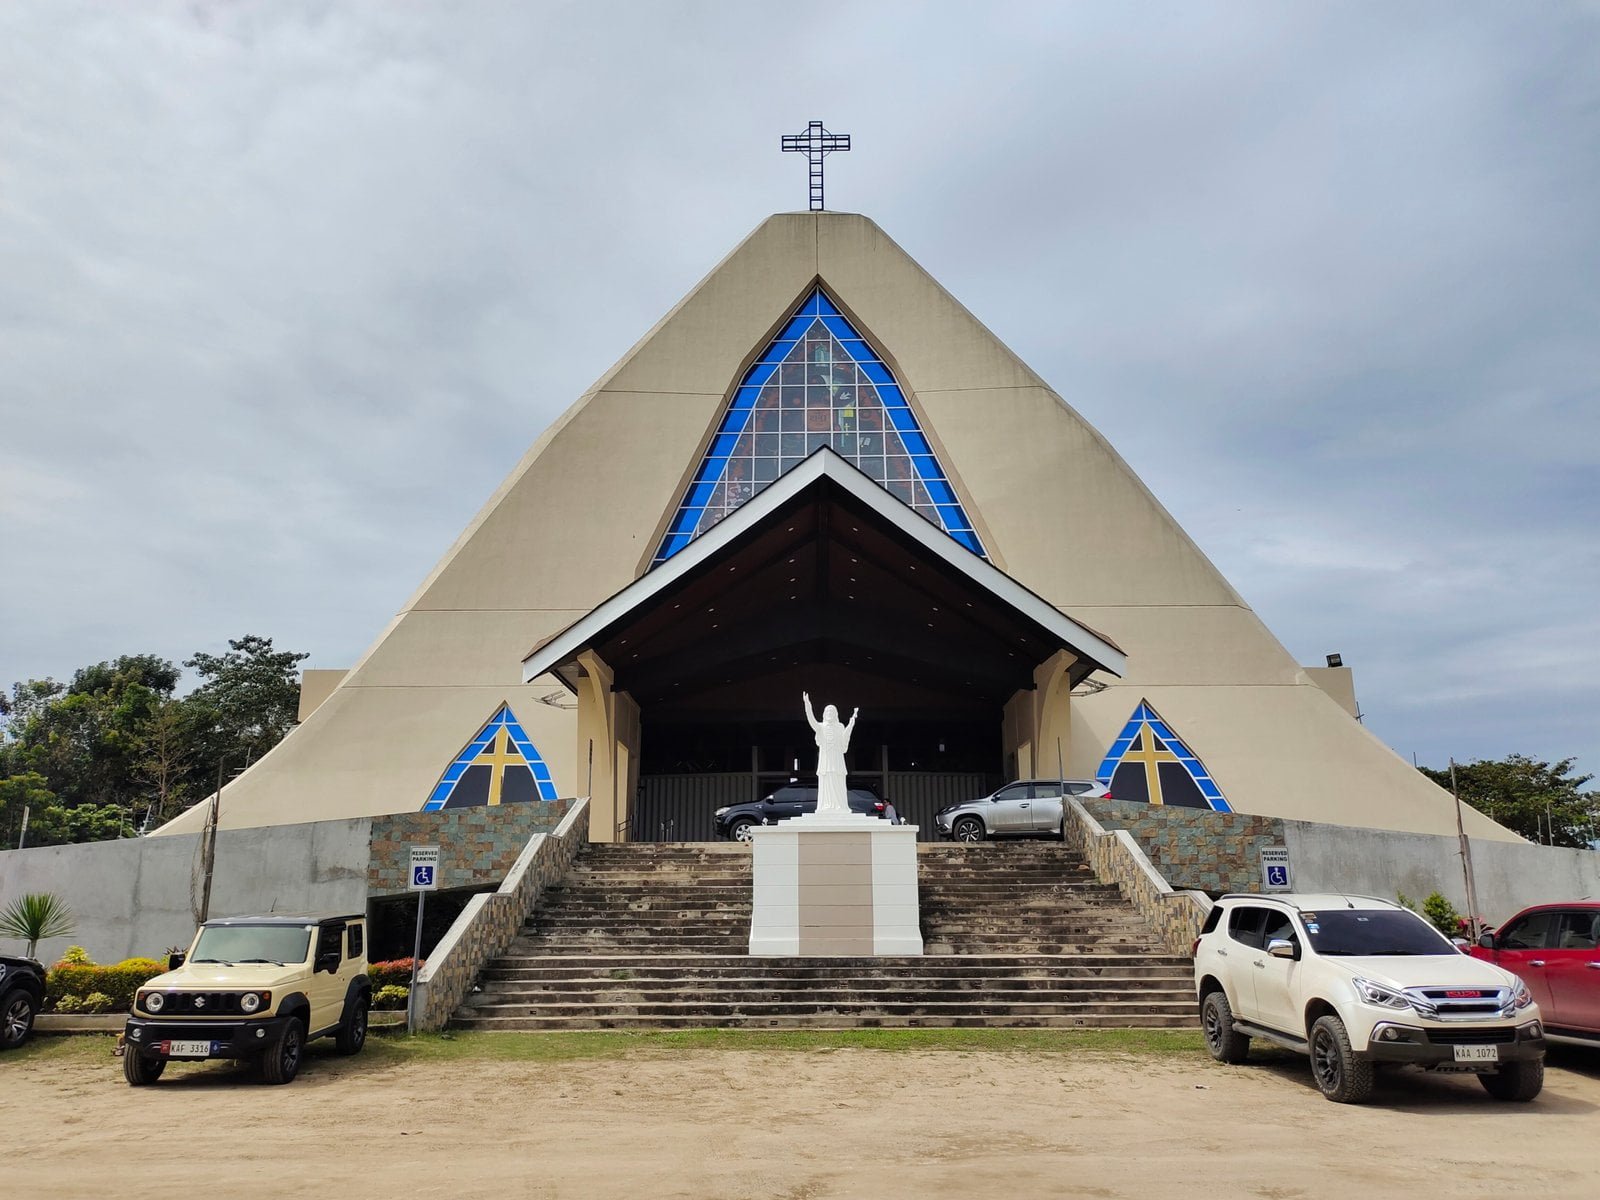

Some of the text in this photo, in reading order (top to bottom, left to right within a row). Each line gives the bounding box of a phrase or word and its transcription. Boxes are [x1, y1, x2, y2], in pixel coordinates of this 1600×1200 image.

[1446, 990, 1481, 998] ISUZU
[171, 1044, 186, 1053] KAF
[190, 1044, 209, 1053] 3316
[1455, 1048, 1497, 1058] KAA 1072
